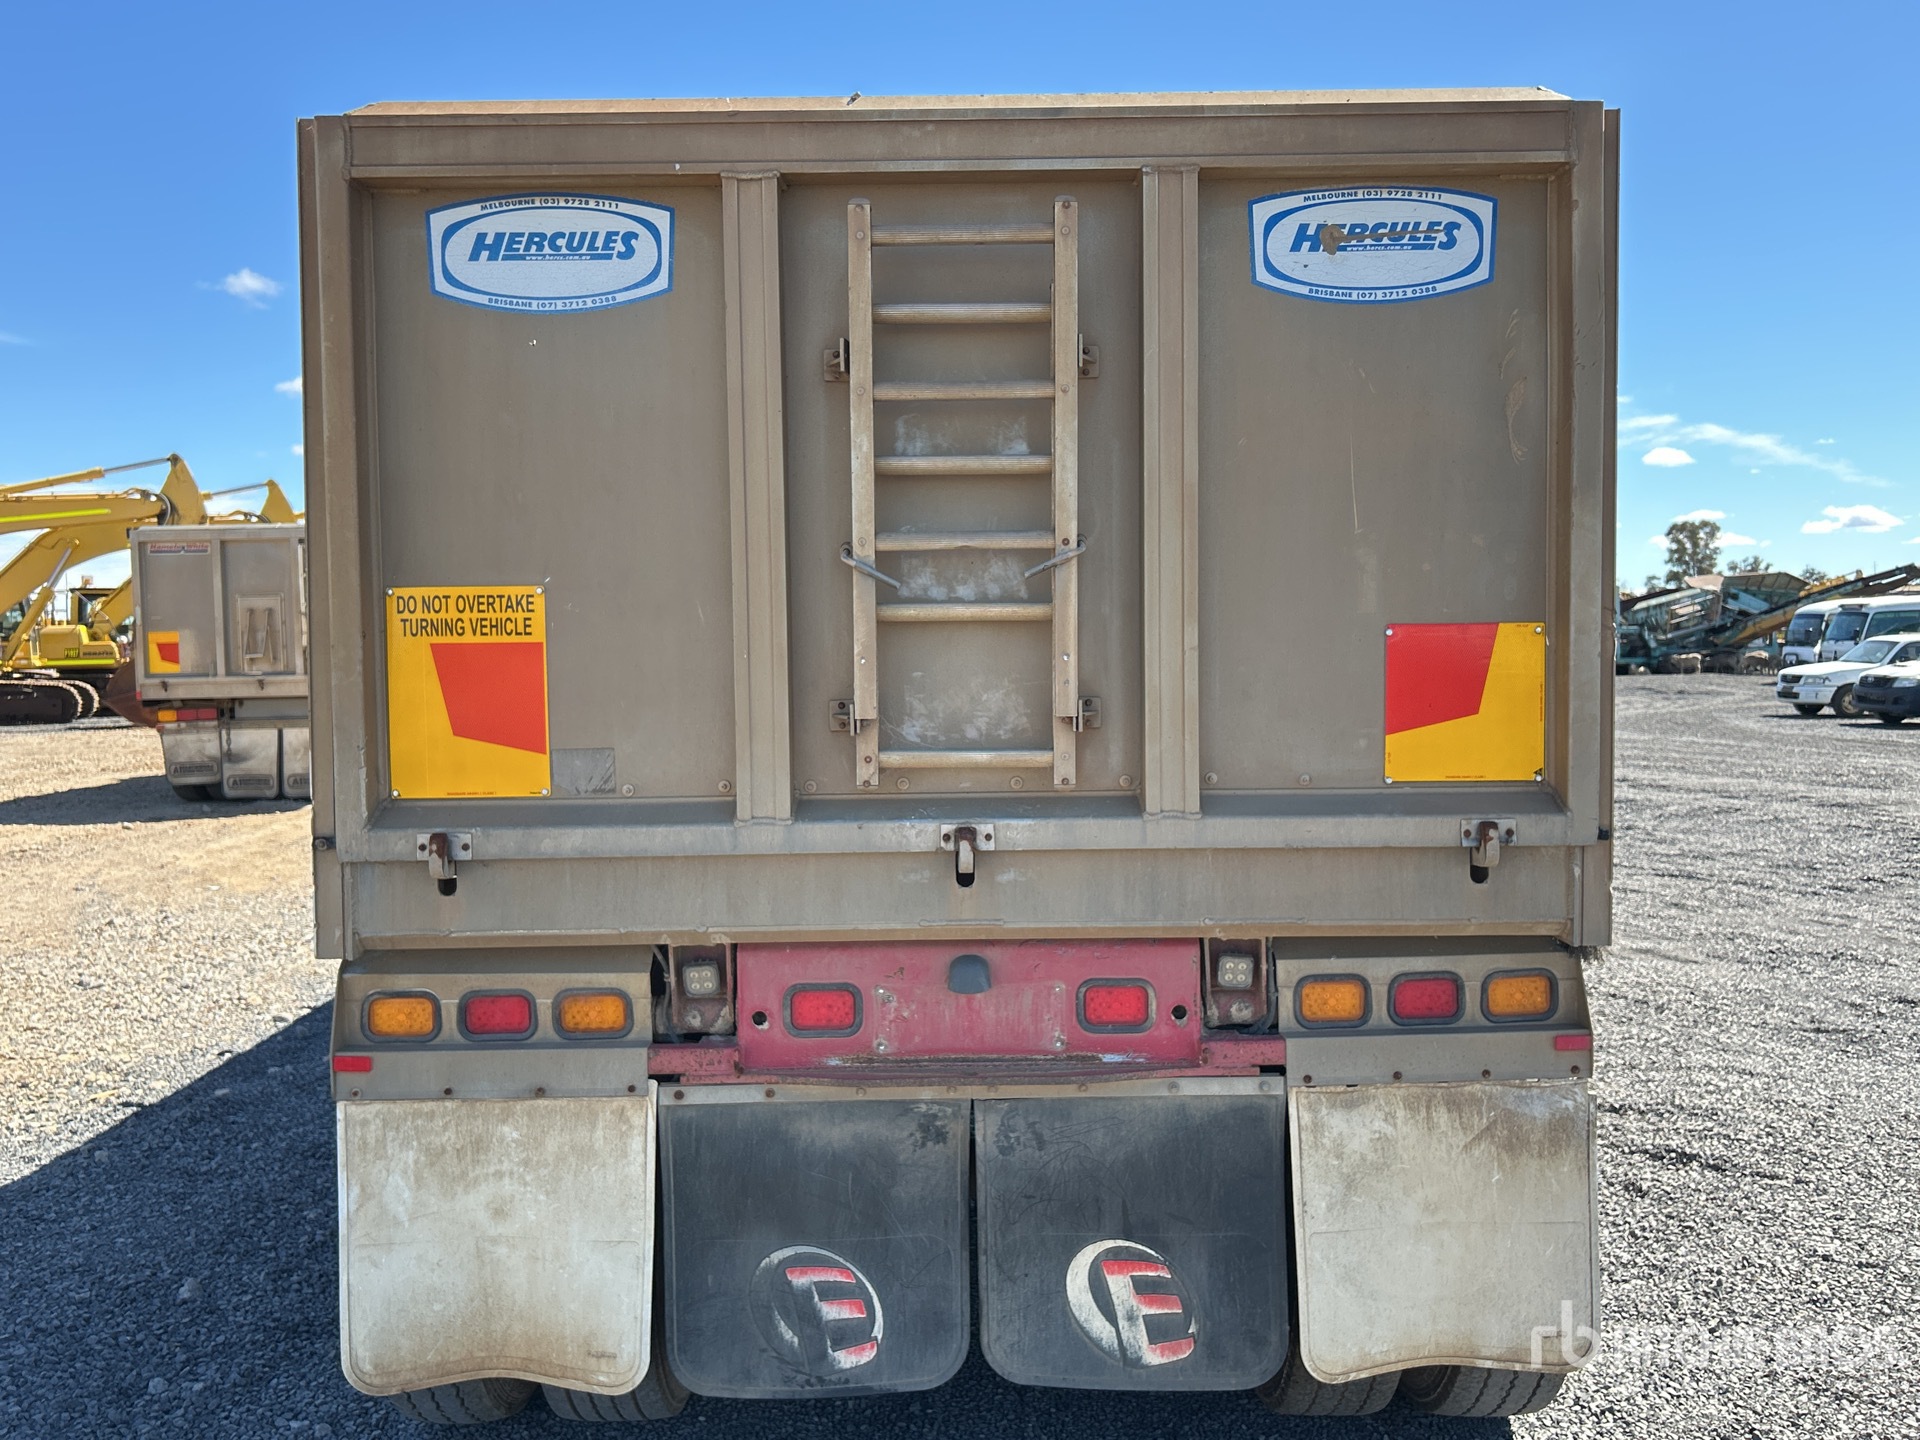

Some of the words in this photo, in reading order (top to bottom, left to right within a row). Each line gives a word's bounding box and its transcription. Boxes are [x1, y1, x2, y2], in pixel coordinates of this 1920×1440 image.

[1303, 190, 1359, 202] MELBOURNE
[1362, 190, 1383, 198] (03)
[1417, 191, 1442, 200] 2111
[480, 198, 536, 211] MELBOURNE
[539, 198, 560, 206] (03)
[564, 198, 590, 206] 9728
[594, 200, 620, 209] 2111
[467, 231, 640, 262] HERCULES
[1308, 288, 1353, 298] BRISBANE
[1356, 292, 1378, 300] (07)
[1381, 290, 1407, 299] 3712
[1412, 286, 1438, 295] 0388
[488, 297, 533, 308] BRISBANE
[536, 302, 558, 310] (07)
[561, 300, 587, 309] 3712
[591, 295, 617, 306] 0388
[396, 595, 417, 614] DO
[422, 595, 451, 614] NOT
[455, 594, 535, 614] OVERTAKE
[400, 618, 465, 637] TURNING
[469, 617, 532, 636] VEHICLE
